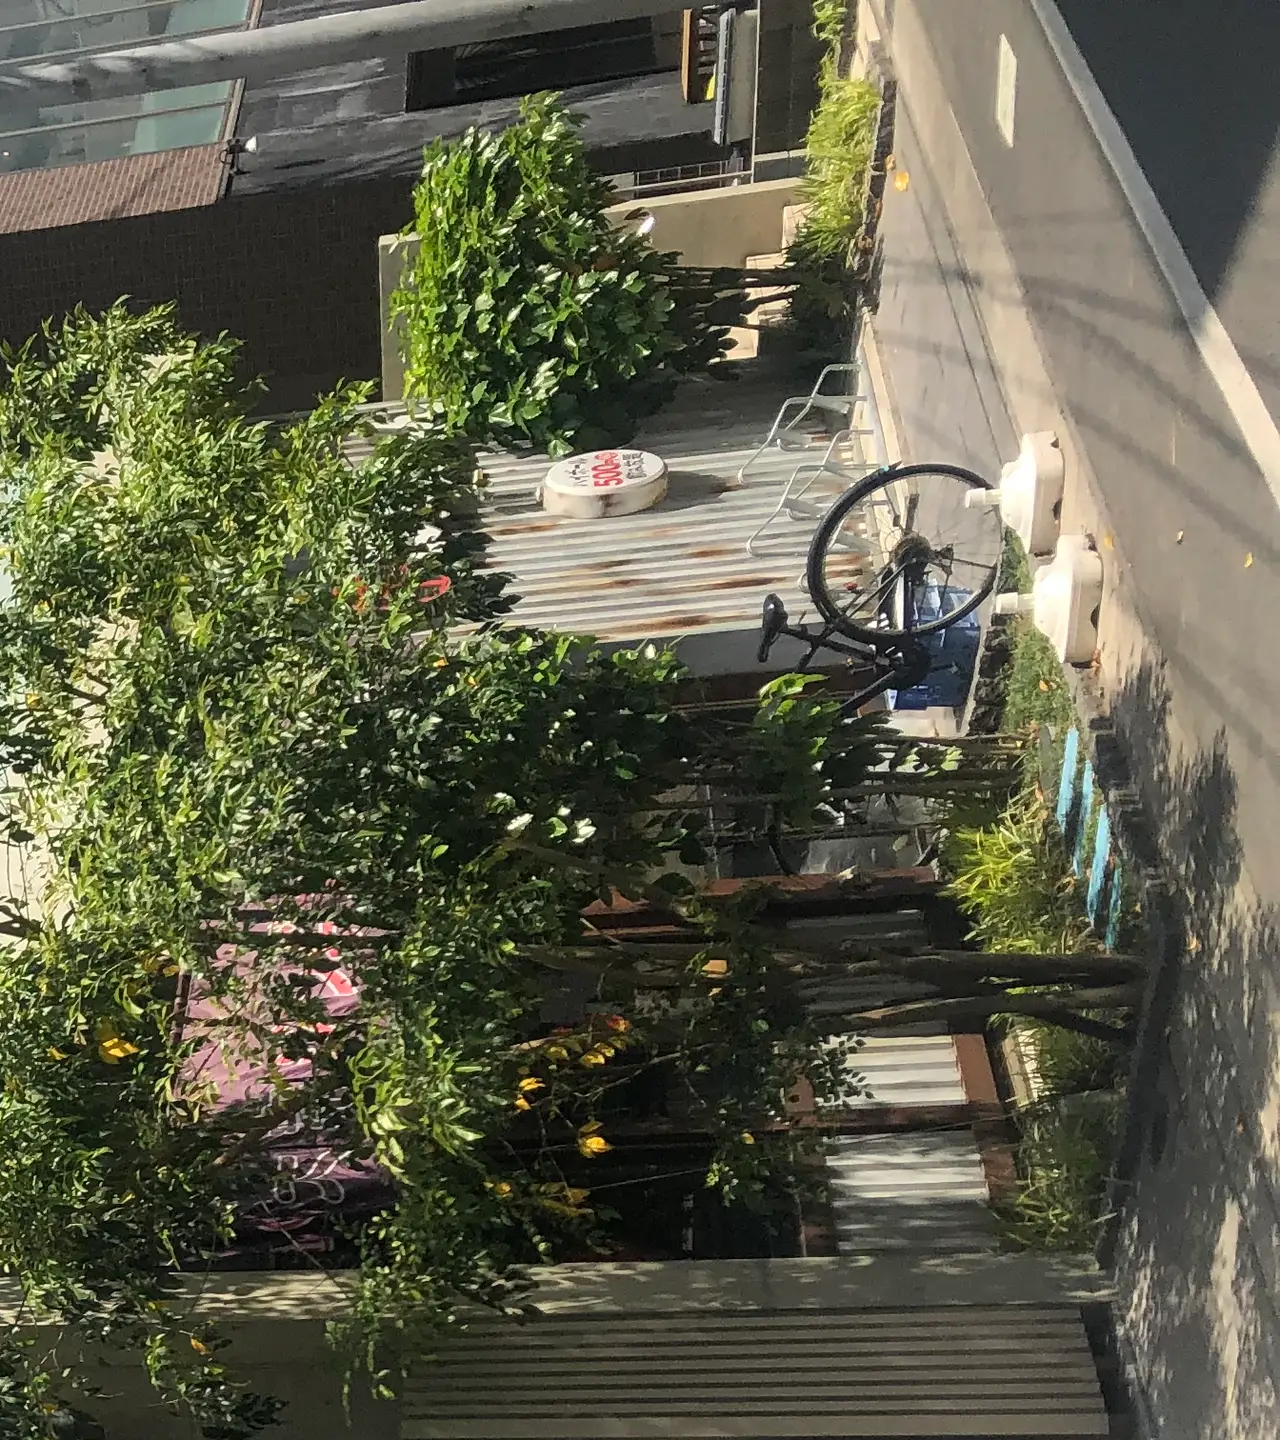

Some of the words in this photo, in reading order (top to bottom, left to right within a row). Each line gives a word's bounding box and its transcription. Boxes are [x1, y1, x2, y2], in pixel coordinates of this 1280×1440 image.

[565, 455, 590, 486] ハイボール
